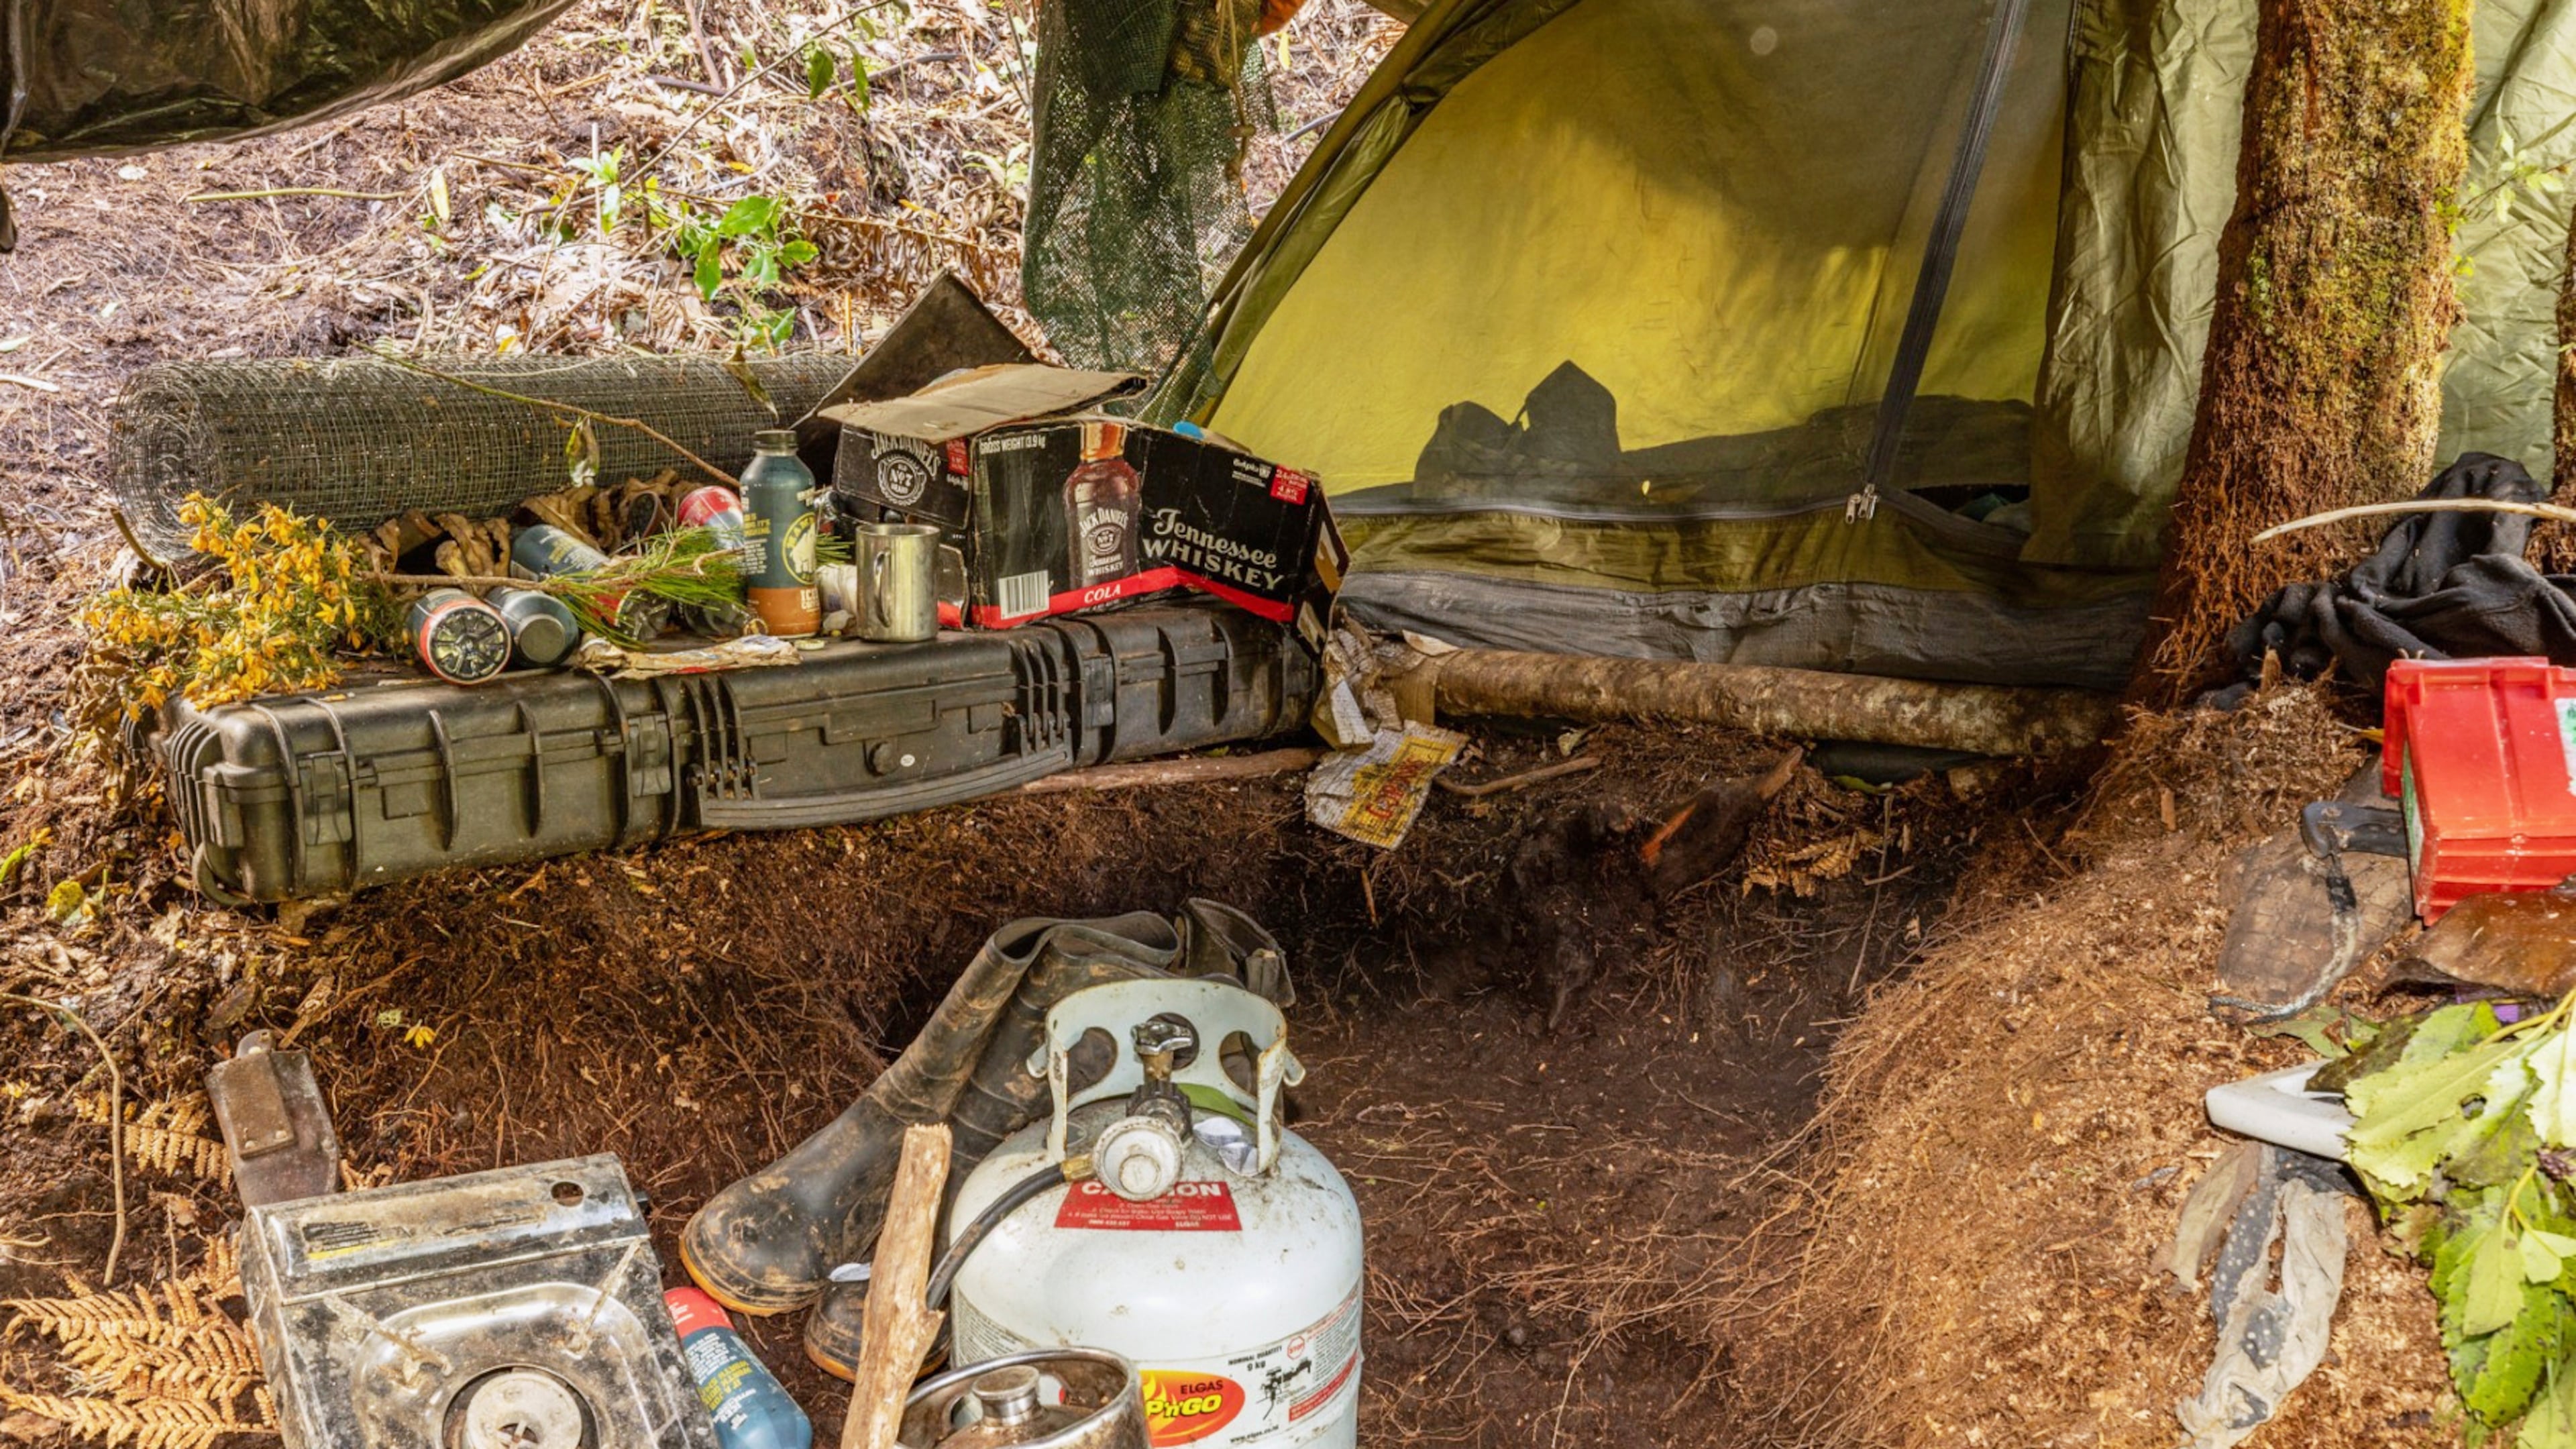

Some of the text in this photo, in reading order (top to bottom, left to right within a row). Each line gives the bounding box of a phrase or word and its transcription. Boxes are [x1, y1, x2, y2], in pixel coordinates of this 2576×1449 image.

[1001, 435, 1024, 451] WEIGHT
[1079, 507, 1129, 537] JACK DANIEL'S
[1153, 508, 1277, 569] Tennessee
[1087, 561, 1124, 576] WHISKEY
[1142, 538, 1285, 591] WHISKEY
[1084, 584, 1121, 604] COLA
[1247, 1360, 1267, 1372] 9 kg
[1181, 1380, 1224, 1395] ELGAS
[1144, 1392, 1222, 1421] P'n'GO
